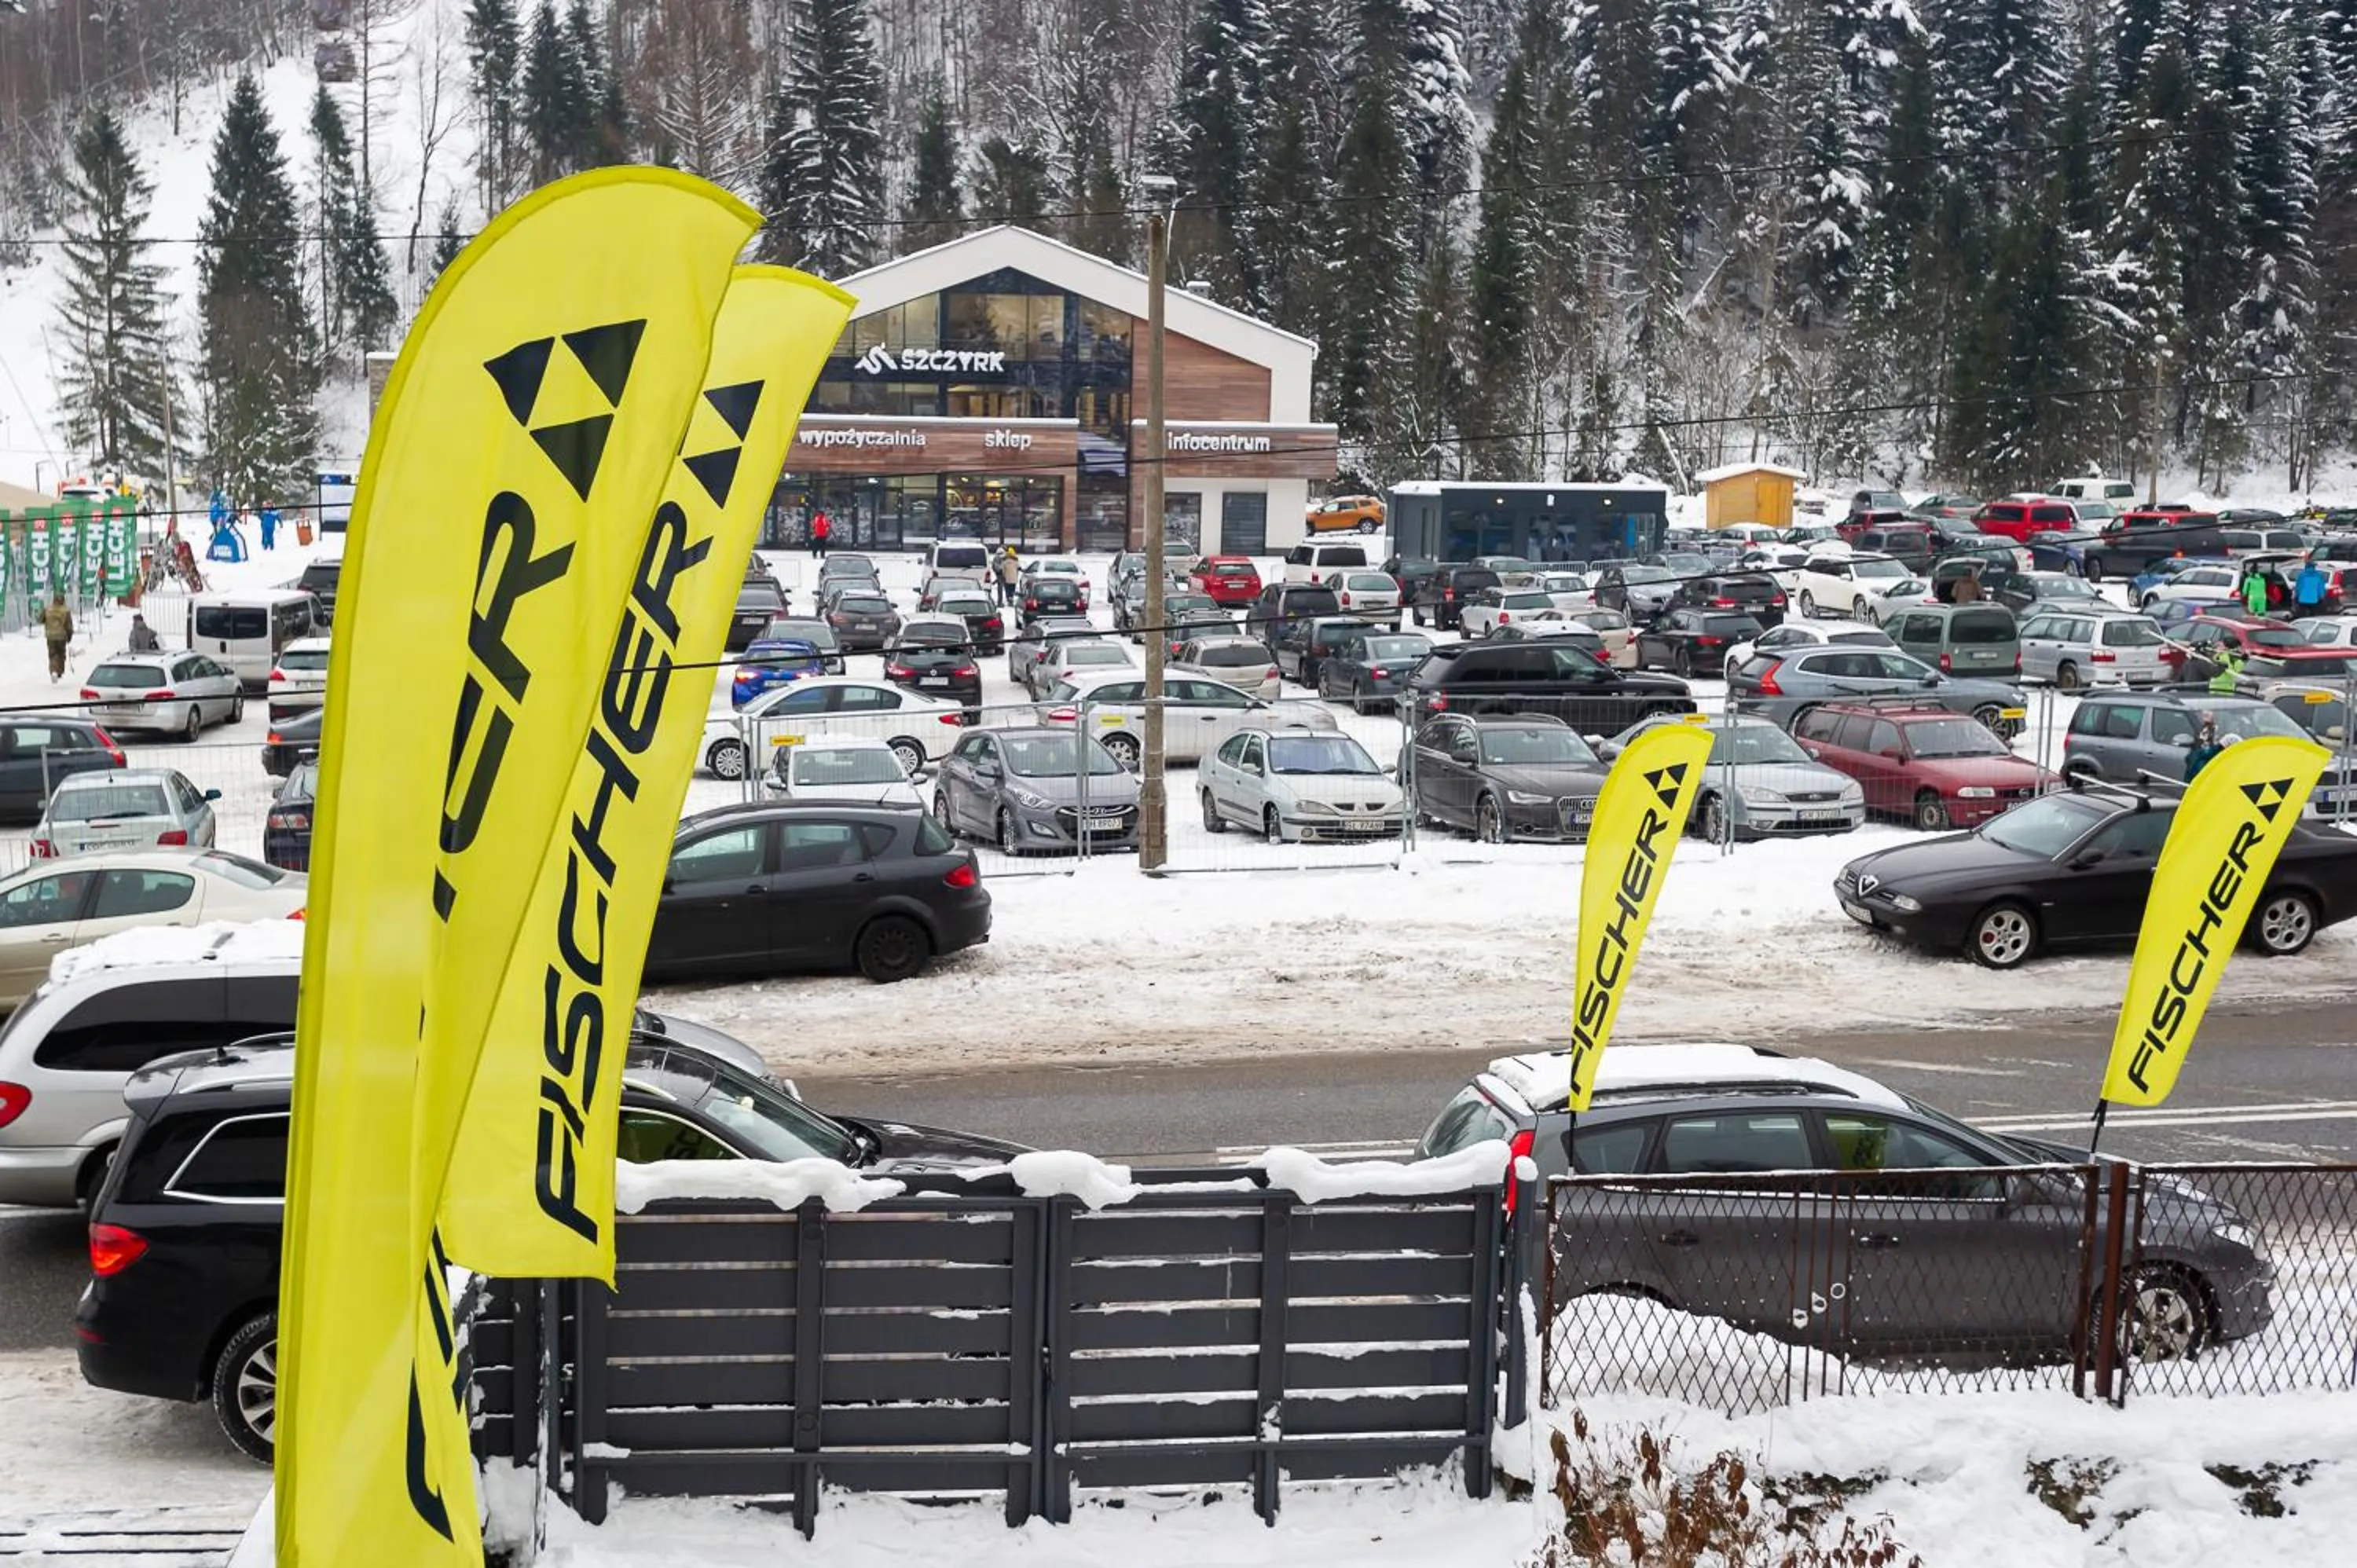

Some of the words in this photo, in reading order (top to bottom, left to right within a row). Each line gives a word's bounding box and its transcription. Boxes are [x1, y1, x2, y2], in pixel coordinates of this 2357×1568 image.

[900, 348, 1005, 372] SZCZYRK
[799, 428, 927, 449] wypożyczalnia
[984, 429, 1032, 450] sklep
[1168, 431, 1271, 452] infocentrum
[107, 520, 126, 581] LECH
[536, 500, 713, 1244] FISCHER
[2127, 821, 2266, 1094] FISCHER
